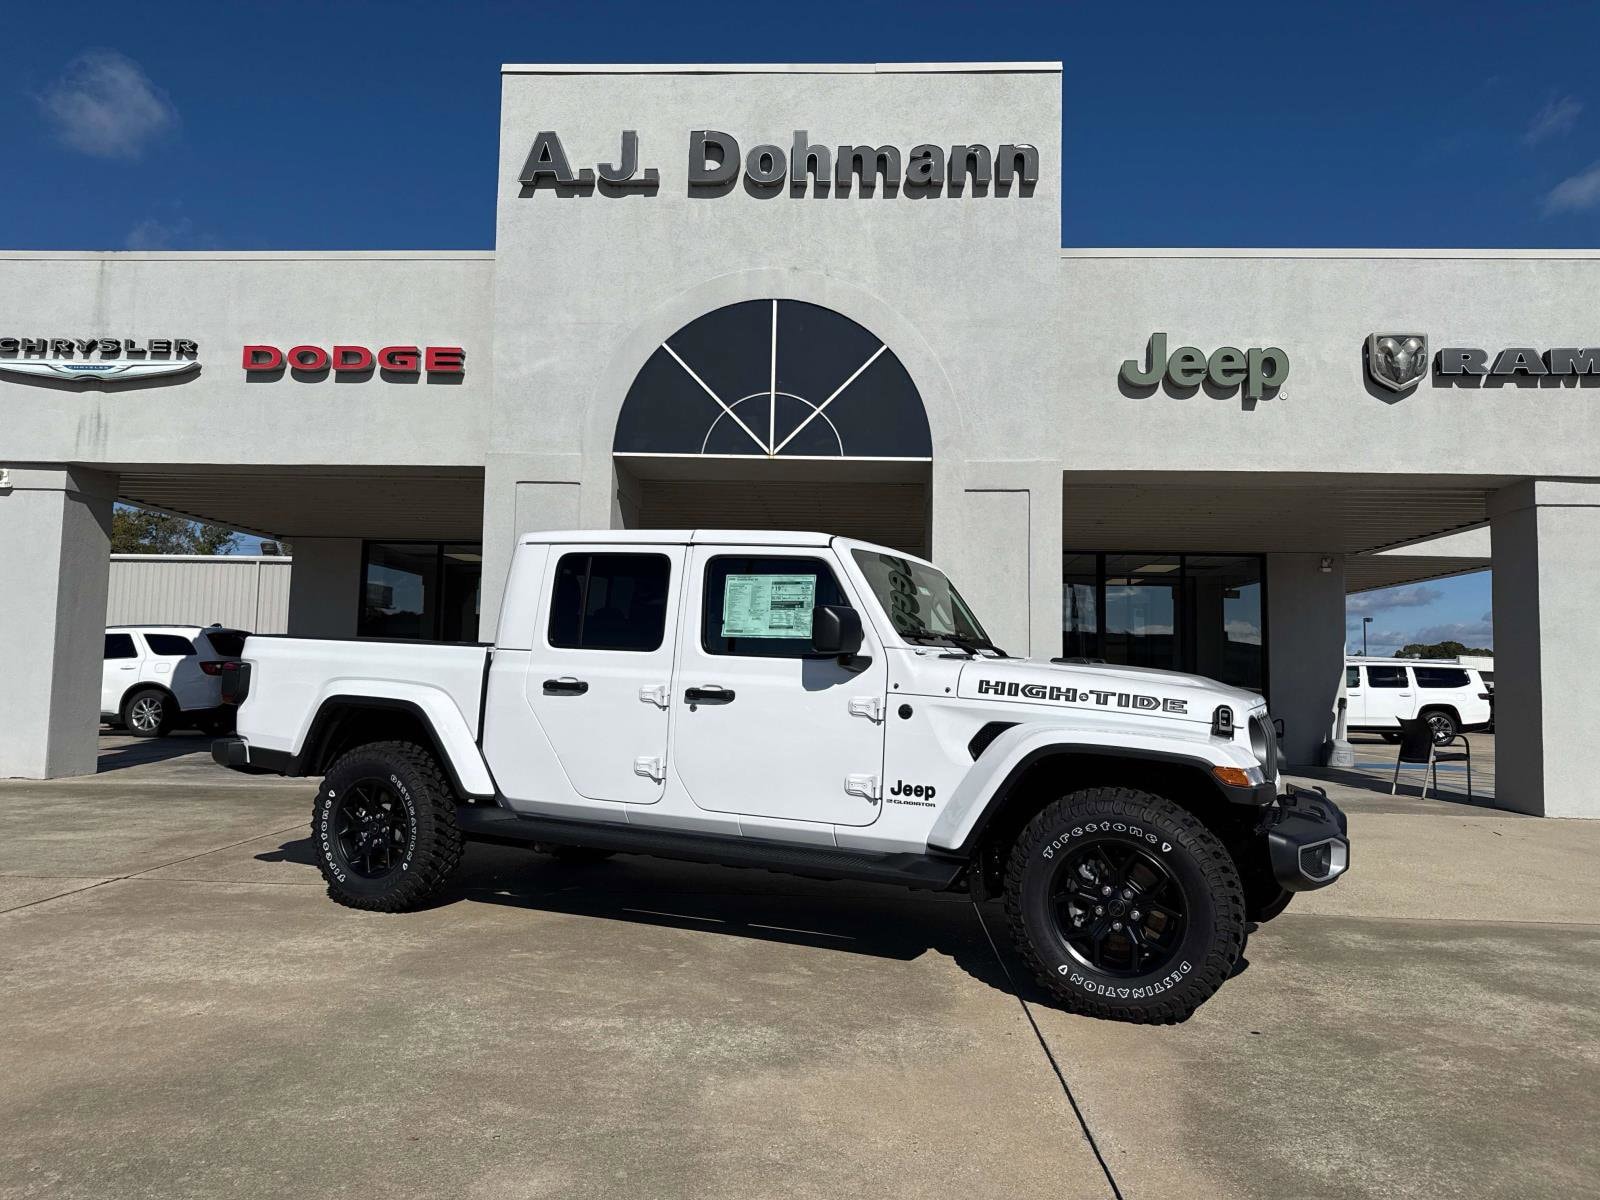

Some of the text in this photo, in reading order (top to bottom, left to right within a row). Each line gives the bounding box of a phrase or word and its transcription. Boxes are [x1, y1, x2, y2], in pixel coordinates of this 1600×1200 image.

[518, 130, 1040, 186] A.J. Dohmann
[0, 337, 199, 354] CHRYSLER
[243, 345, 465, 373] DODGE
[1440, 347, 1600, 374] RAM
[1121, 332, 1290, 398] Jeep
[978, 679, 1188, 714] HIGH TIDE
[890, 779, 936, 801] Jeep
[893, 799, 936, 808] GLADIATOR
[1042, 821, 1158, 859] Firestone
[1070, 960, 1192, 998] DESTINATION
